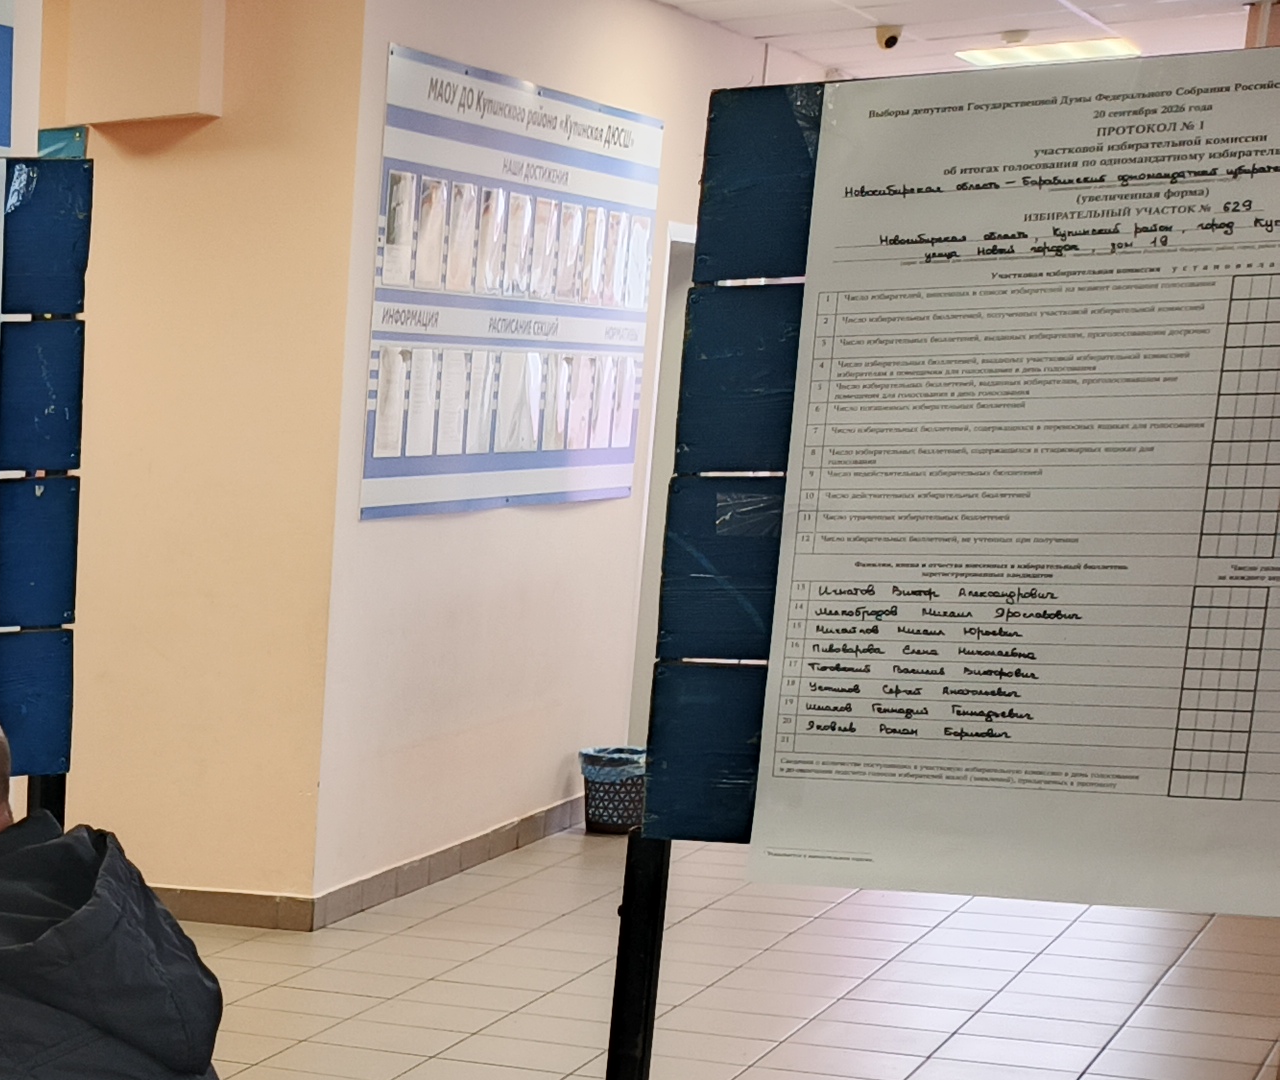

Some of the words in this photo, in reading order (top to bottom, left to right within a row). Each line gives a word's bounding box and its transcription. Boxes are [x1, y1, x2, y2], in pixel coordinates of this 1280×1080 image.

[427, 77, 457, 106] МАОУ
[458, 86, 474, 113] ДО
[475, 91, 525, 123] Купинского
[526, 105, 558, 131] района
[868, 108, 910, 118] Выборы
[911, 104, 964, 117] депутатов
[967, 96, 1058, 112] Государственной
[1059, 93, 1092, 106] Думы
[1095, 88, 1173, 103] Федерального
[1176, 84, 1231, 97] Собрания
[1093, 108, 1106, 119] 20
[1108, 105, 1159, 119] сентября
[1160, 103, 1186, 114] 2026
[1188, 102, 1214, 113] года
[1096, 121, 1177, 137] ПРОТОКОЛ
[1179, 120, 1196, 132] №
[1033, 139, 1104, 158] участковой
[1106, 134, 1202, 152] избирательной
[1205, 134, 1268, 146] комиссии
[942, 165, 958, 176] об
[960, 162, 1000, 175] итогах
[1002, 156, 1078, 172] голосования
[1082, 158, 1097, 169] по
[1099, 148, 1206, 168] одномандатному
[502, 158, 524, 177] НАШИ
[524, 162, 570, 186] ДОСТИЖЕНИЯ
[844, 183, 944, 199] Новосибирская
[956, 181, 1001, 191] область
[1074, 188, 1160, 205] (увеличенная
[1163, 186, 1211, 201] форма)
[1023, 206, 1132, 223] ИЗБИРАТЕЛЬНЫЙ
[1136, 203, 1197, 218] УЧАСТОК
[1222, 200, 1253, 213] 629
[879, 232, 967, 248] Новосибирская
[991, 269, 1044, 281] Участковая
[1116, 264, 1162, 275] комиссия
[381, 306, 439, 332] ИНФОРМАЦИЯ
[487, 316, 532, 336] РАСПИСАНИЕ
[532, 317, 559, 340] СЕКЦИЙ
[818, 583, 876, 597] Игнатов
[958, 587, 1059, 605] Александрович
[815, 624, 880, 635] Михайлов
[812, 643, 886, 658] Пивоварова
[963, 666, 1040, 680] Викторович
[871, 703, 929, 720] Геннадий
[878, 723, 919, 737] Роман
